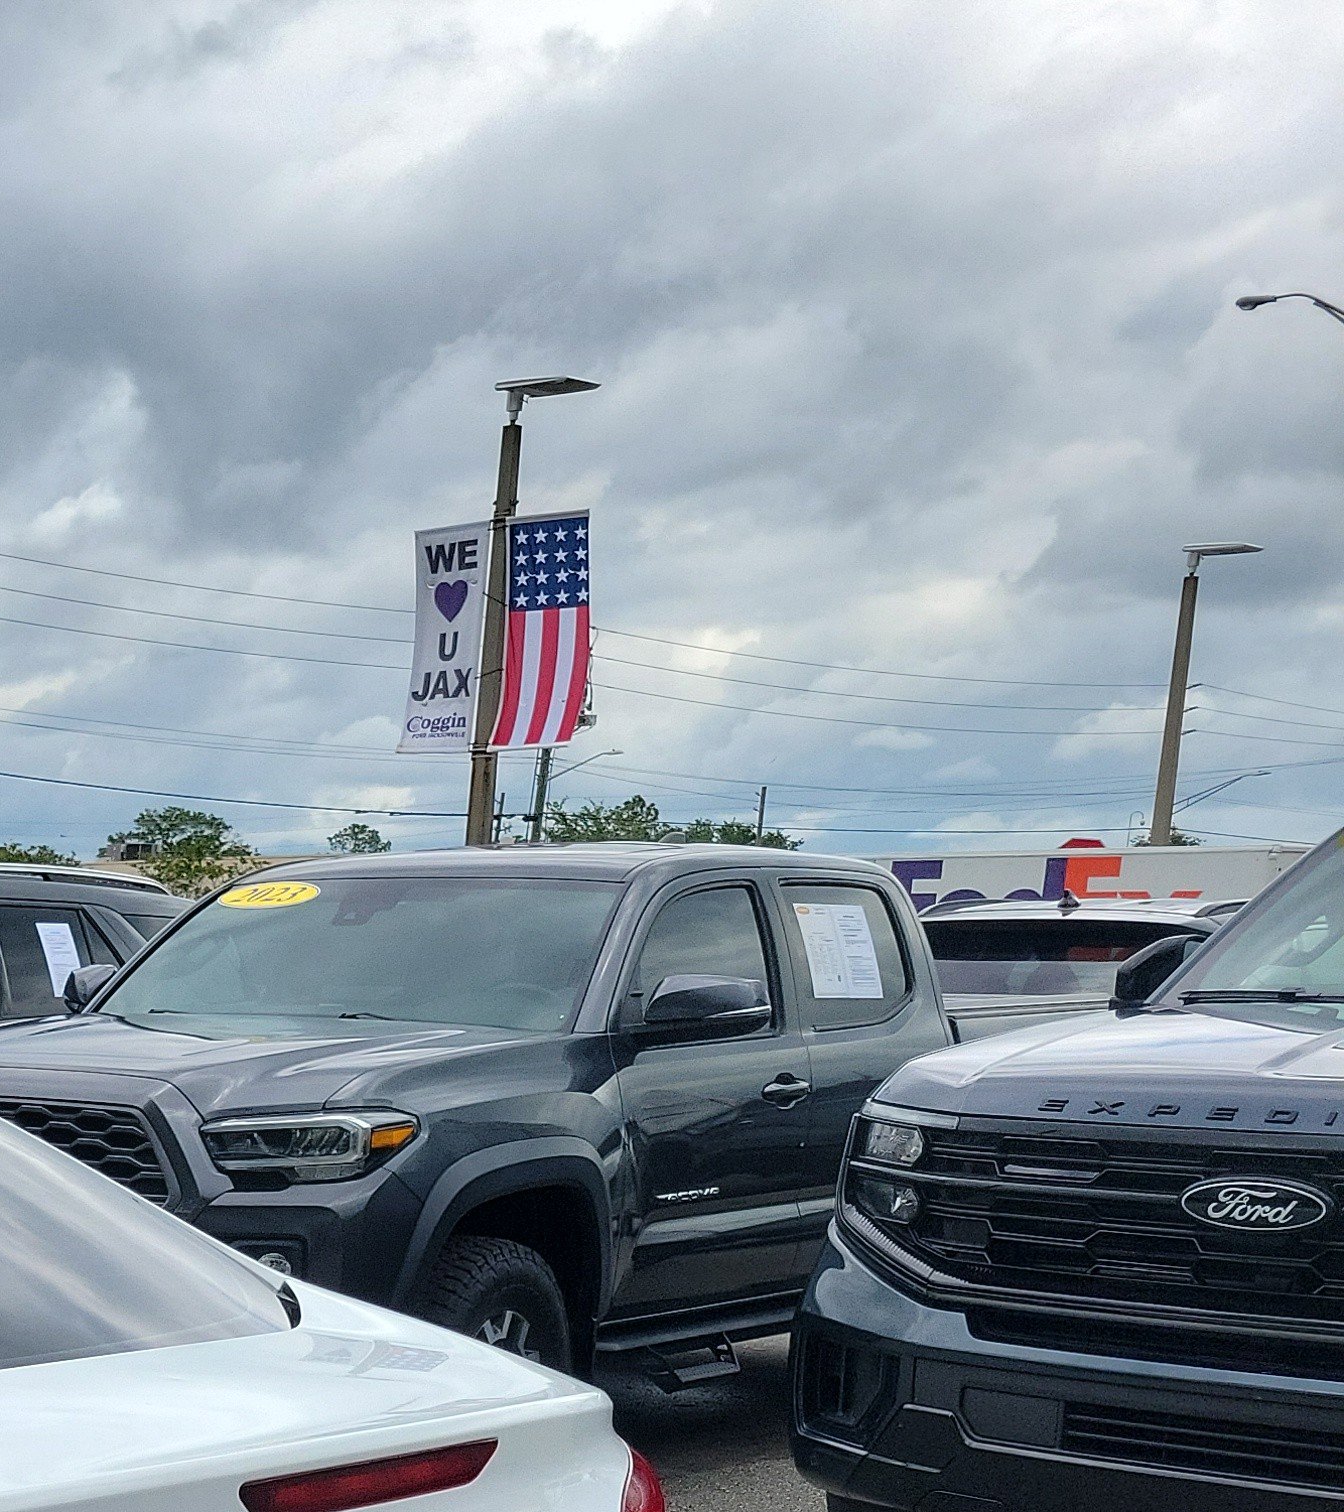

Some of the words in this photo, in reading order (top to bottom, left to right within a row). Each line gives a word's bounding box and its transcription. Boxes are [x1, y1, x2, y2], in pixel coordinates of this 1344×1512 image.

[425, 539, 479, 574] WE
[438, 631, 458, 662] U
[411, 667, 473, 702] JAX
[407, 712, 466, 733] Coggin
[229, 886, 308, 903] 2023
[1038, 1098, 1340, 1126] EXPEDI
[1206, 1187, 1299, 1224] Ford
